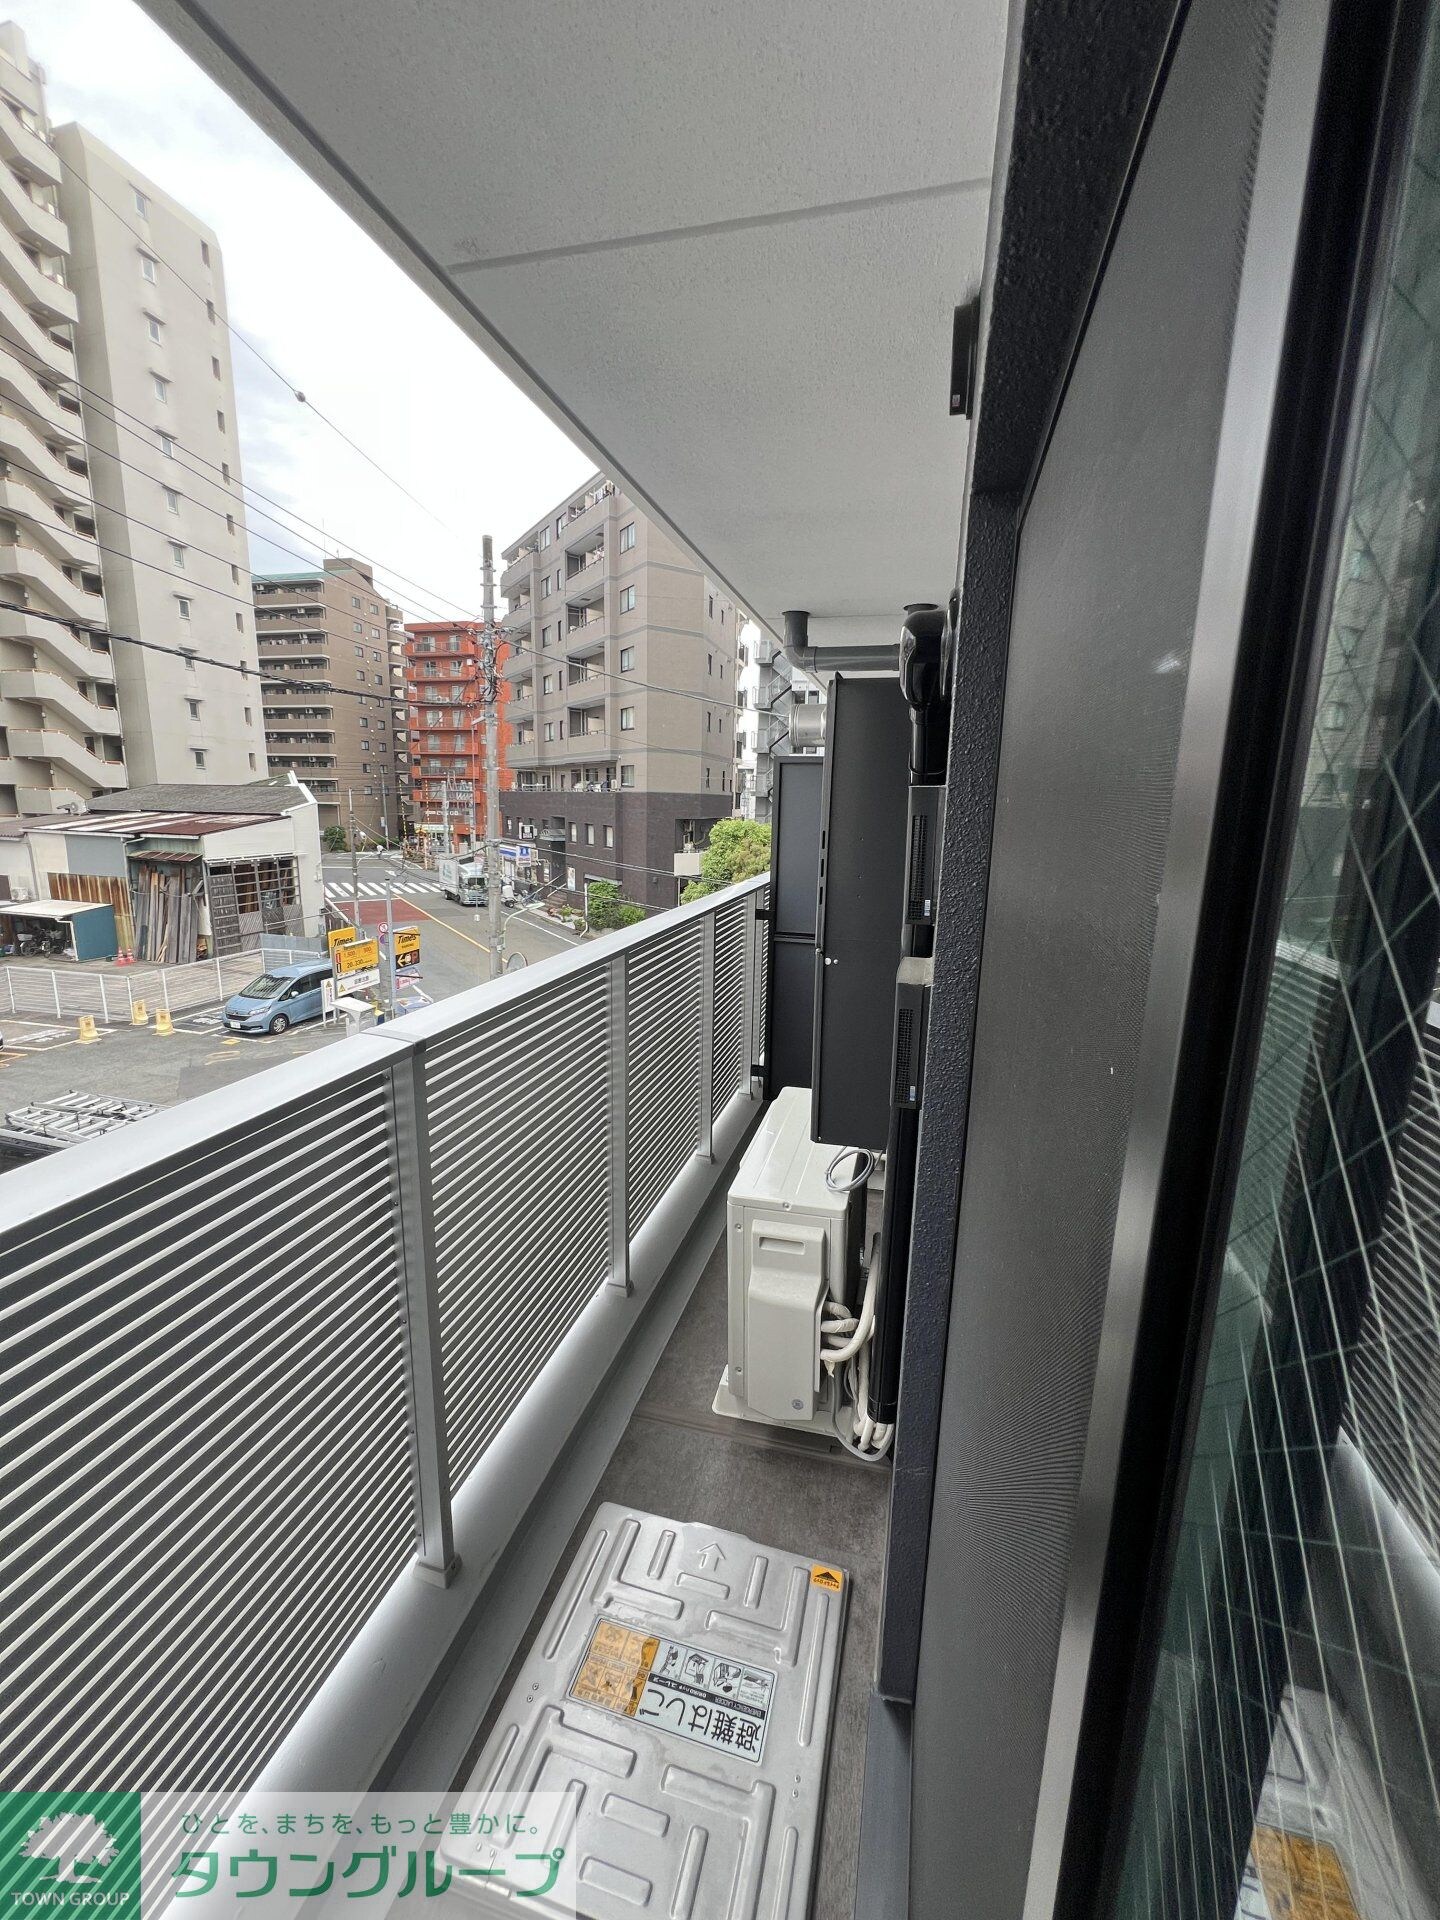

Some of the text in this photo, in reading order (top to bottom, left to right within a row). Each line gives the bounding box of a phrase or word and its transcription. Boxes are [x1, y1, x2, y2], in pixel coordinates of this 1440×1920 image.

[333, 937, 354, 947] Times
[398, 934, 416, 944] Times
[714, 1696, 733, 1708] LADDER
[639, 1688, 762, 1753] 避難はしご
